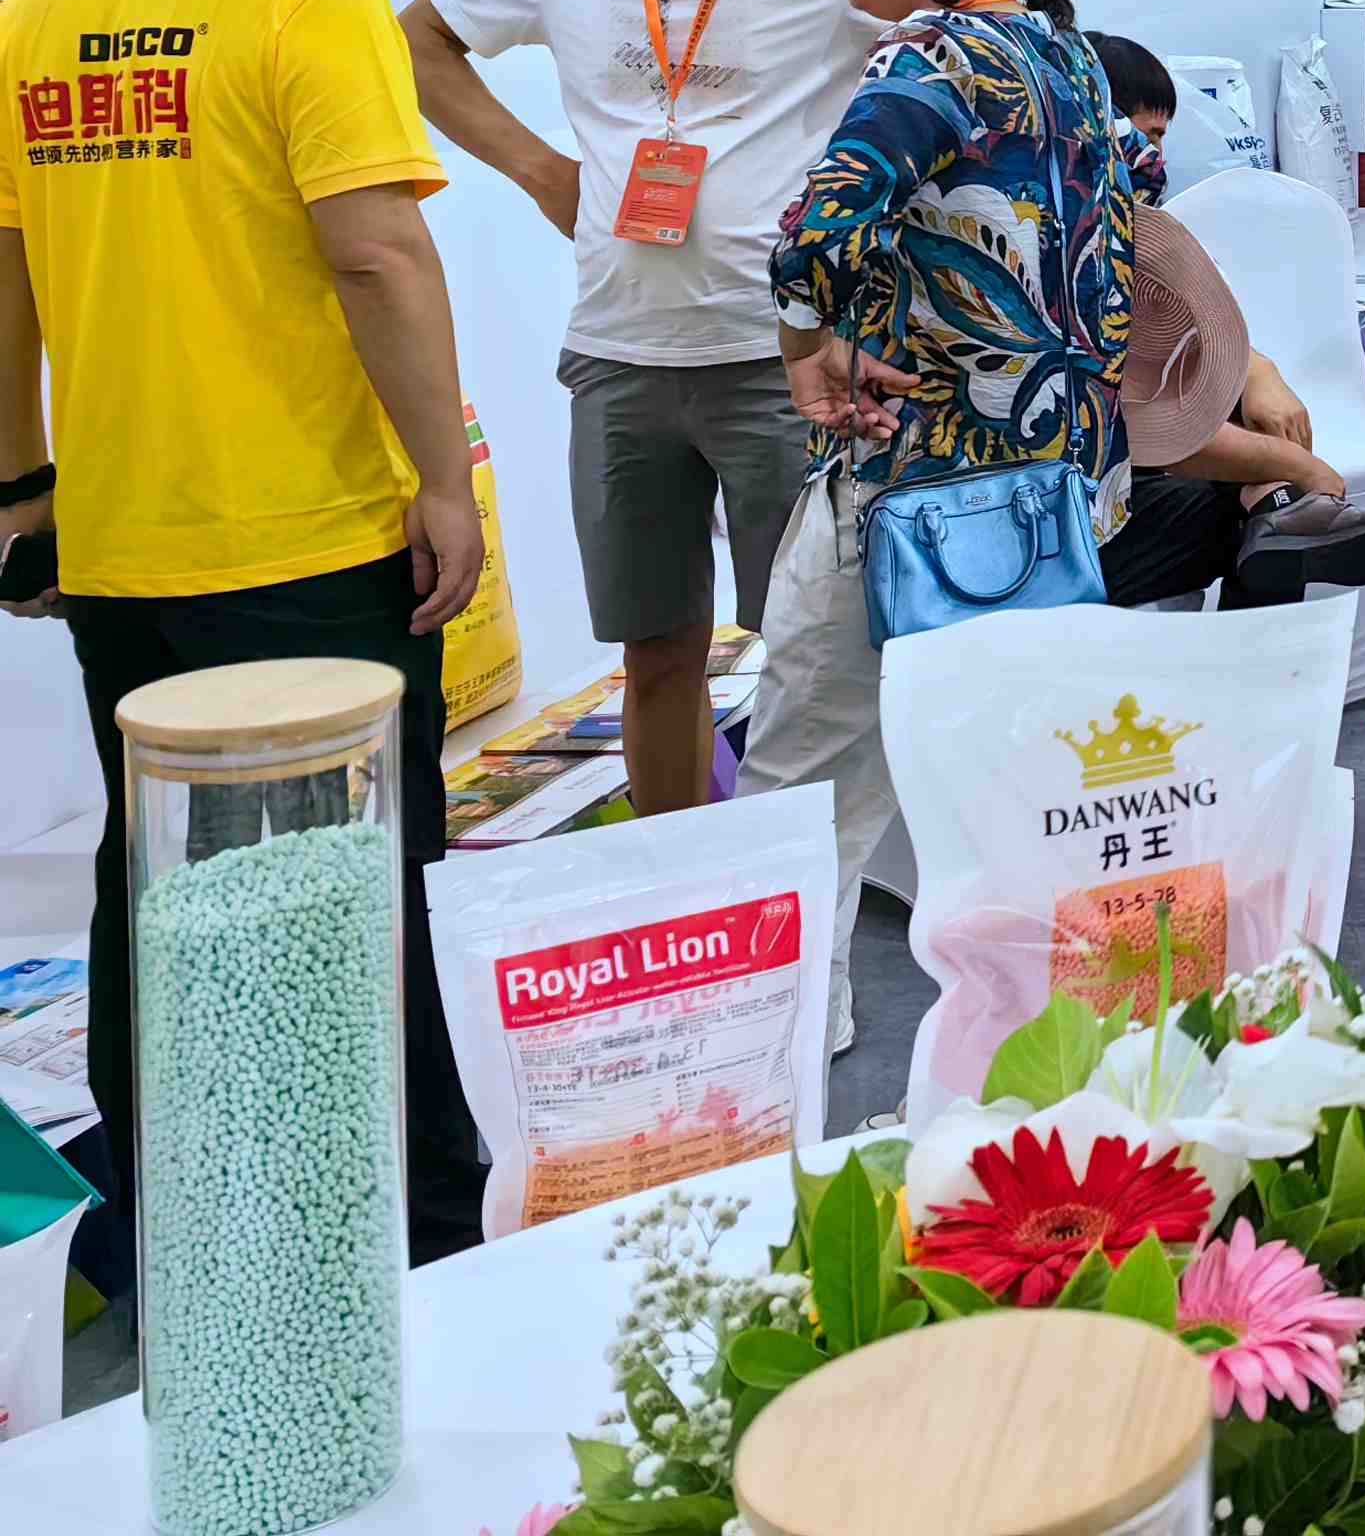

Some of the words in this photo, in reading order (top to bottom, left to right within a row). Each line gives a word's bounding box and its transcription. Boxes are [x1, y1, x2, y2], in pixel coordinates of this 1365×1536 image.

[78, 26, 195, 63] DISCO
[18, 67, 190, 143] 迪斯科
[1042, 778, 1219, 837] DANWANG
[1099, 825, 1173, 871] 丹王
[505, 945, 630, 1007] Royal
[640, 927, 731, 973] Lion
